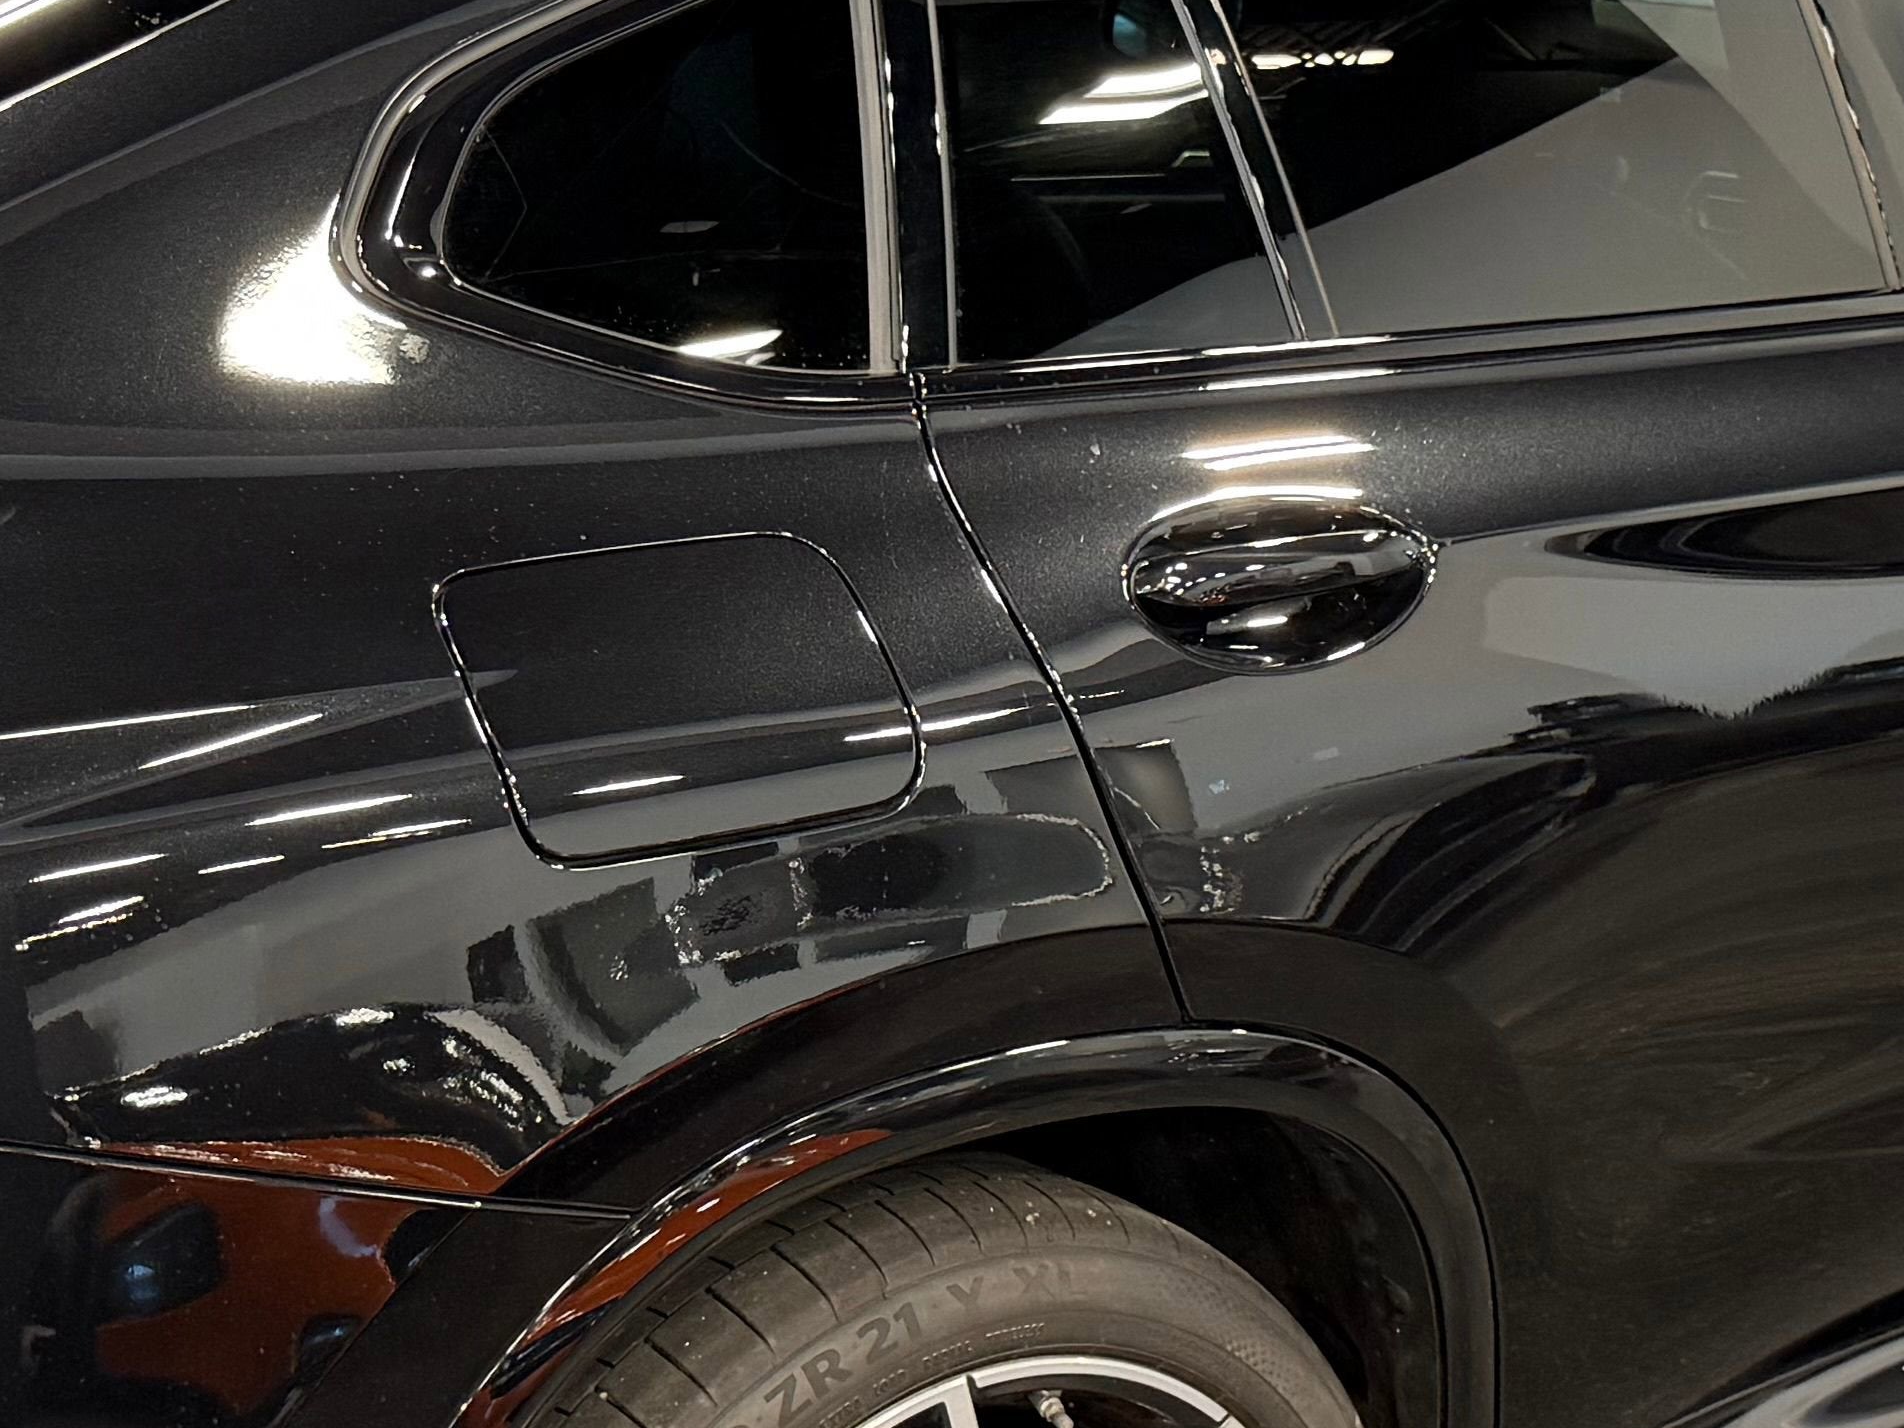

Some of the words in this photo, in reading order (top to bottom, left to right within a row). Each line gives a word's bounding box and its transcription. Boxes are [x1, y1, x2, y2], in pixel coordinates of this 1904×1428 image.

[856, 1301, 924, 1366] 21
[946, 1275, 984, 1312] Y
[1012, 1261, 1089, 1304] XL
